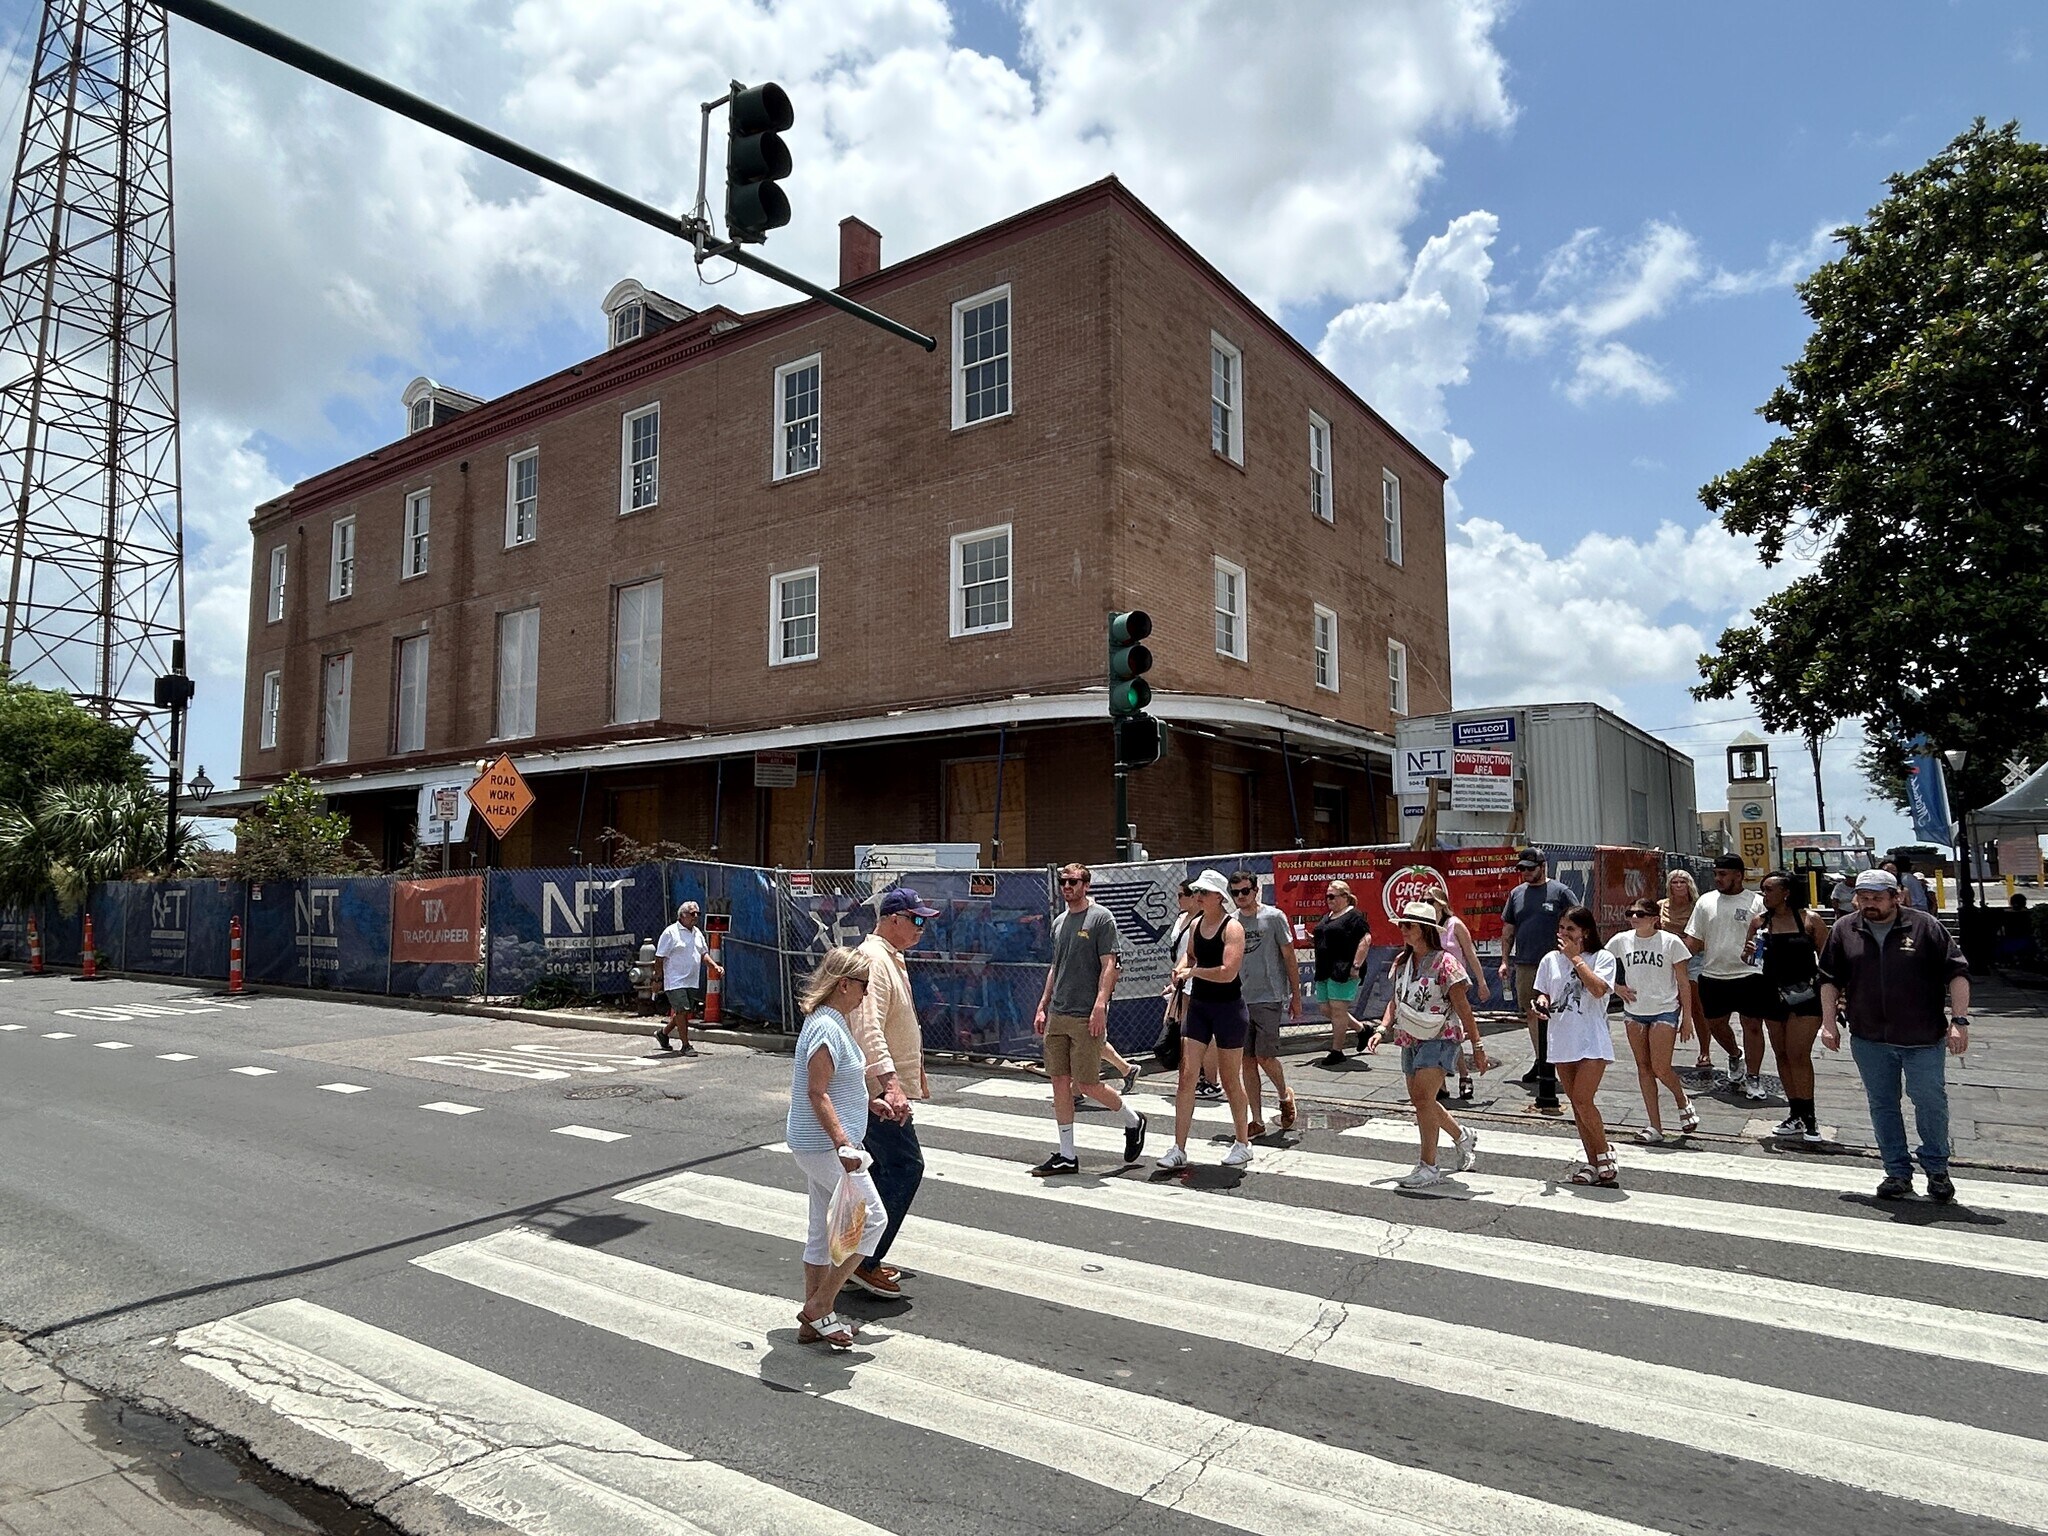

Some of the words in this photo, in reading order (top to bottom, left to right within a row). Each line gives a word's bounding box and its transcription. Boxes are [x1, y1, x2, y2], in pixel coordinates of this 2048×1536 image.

[1463, 724, 1505, 735] WILLSCOT
[1407, 750, 1446, 771] NFT
[1455, 753, 1511, 765] CONSTRUCTION
[1473, 765, 1493, 775] AREA
[490, 775, 516, 786] ROAD
[489, 790, 515, 801] WORK
[485, 805, 517, 816] AHEAD
[1405, 807, 1424, 815] OFFICE
[1743, 827, 1763, 840] EB
[1744, 843, 1765, 856] 58
[1277, 861, 1302, 869] ROUSES
[1303, 860, 1327, 868] FRENCH
[1328, 859, 1352, 867] MARKET
[1372, 858, 1392, 866] STAGE
[1289, 874, 1309, 882] SOFAB
[1309, 873, 1337, 881] COOKING
[1337, 872, 1354, 880] DEMO
[152, 890, 186, 928] NFT
[295, 889, 339, 934] NFT
[542, 878, 635, 934] NFT
[1625, 951, 1664, 967] TEXAS
[54, 998, 252, 1021] ONLY
[408, 1044, 661, 1080] BUS
